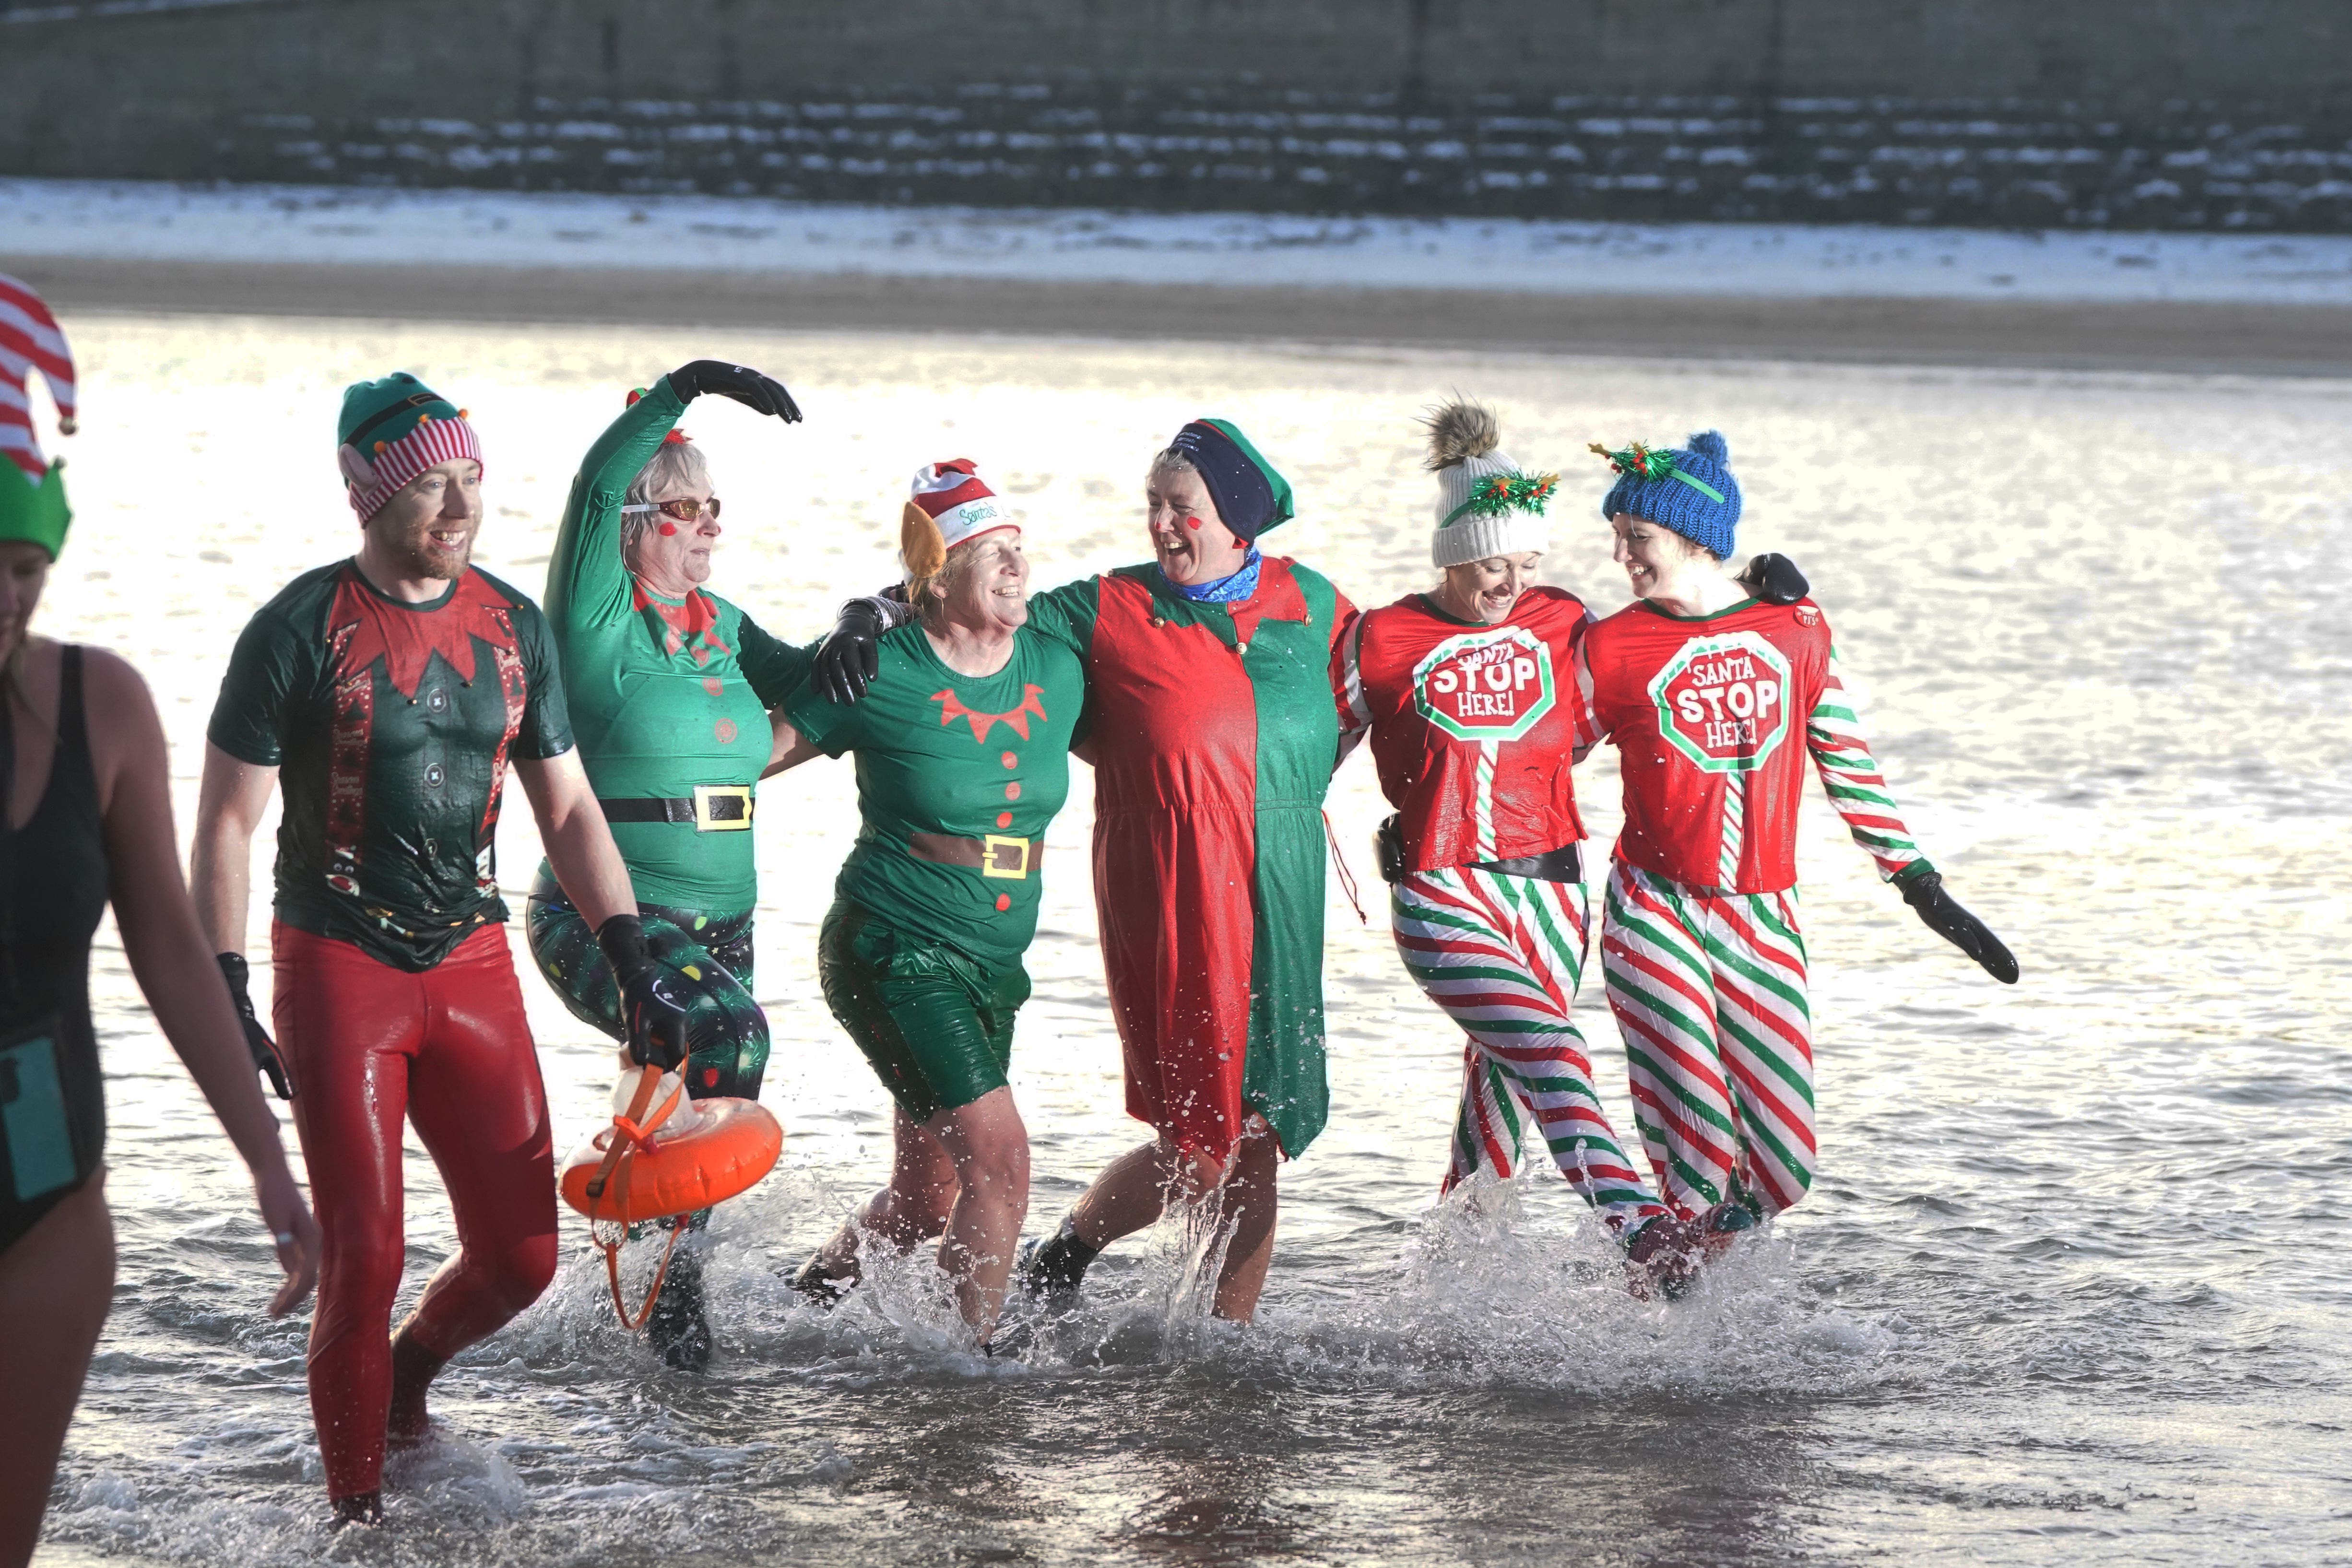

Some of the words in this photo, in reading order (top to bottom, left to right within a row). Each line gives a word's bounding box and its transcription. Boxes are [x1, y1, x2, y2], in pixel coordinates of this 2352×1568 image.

[959, 502, 997, 525] Santa's
[1457, 643, 1514, 668] SANTA
[1434, 657, 1536, 693] STOP
[1692, 656, 1756, 686] SANTA
[1456, 690, 1515, 717] HERE!
[1677, 680, 1778, 723] STOP
[1705, 718, 1758, 748] HERE!
